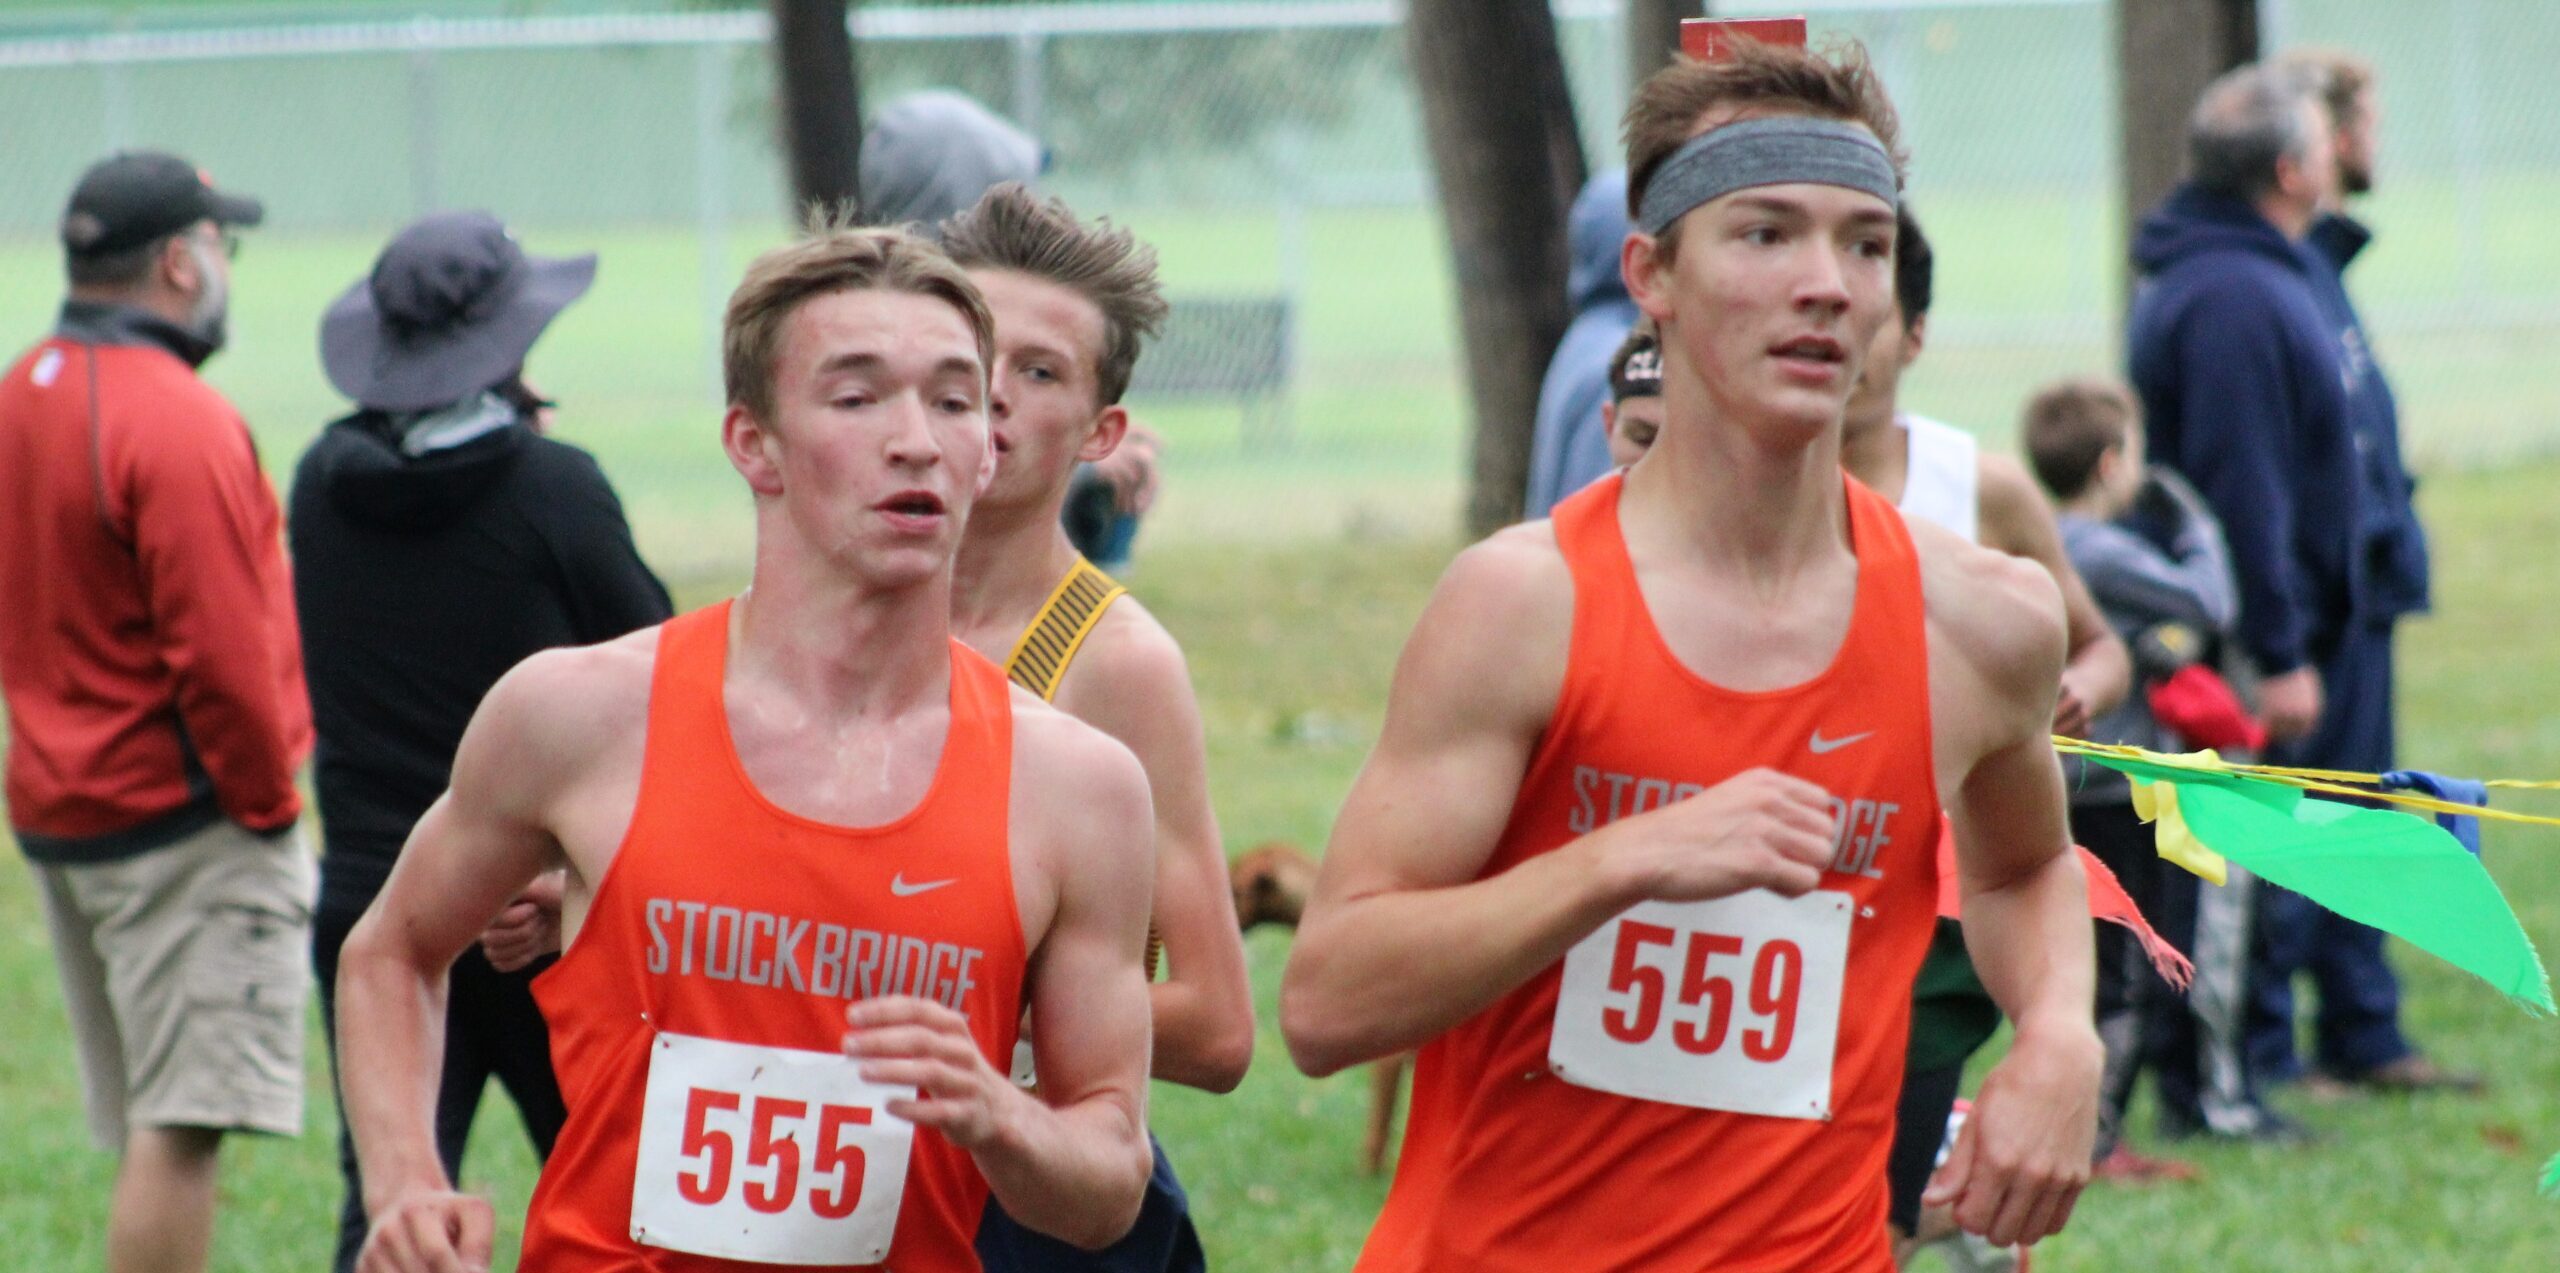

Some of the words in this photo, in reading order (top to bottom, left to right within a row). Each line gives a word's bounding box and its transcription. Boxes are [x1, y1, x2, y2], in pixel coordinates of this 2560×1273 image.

[646, 898, 983, 1022] STOCKBRIDGE
[1602, 919, 1803, 1063] 559
[676, 1086, 873, 1220] 555
